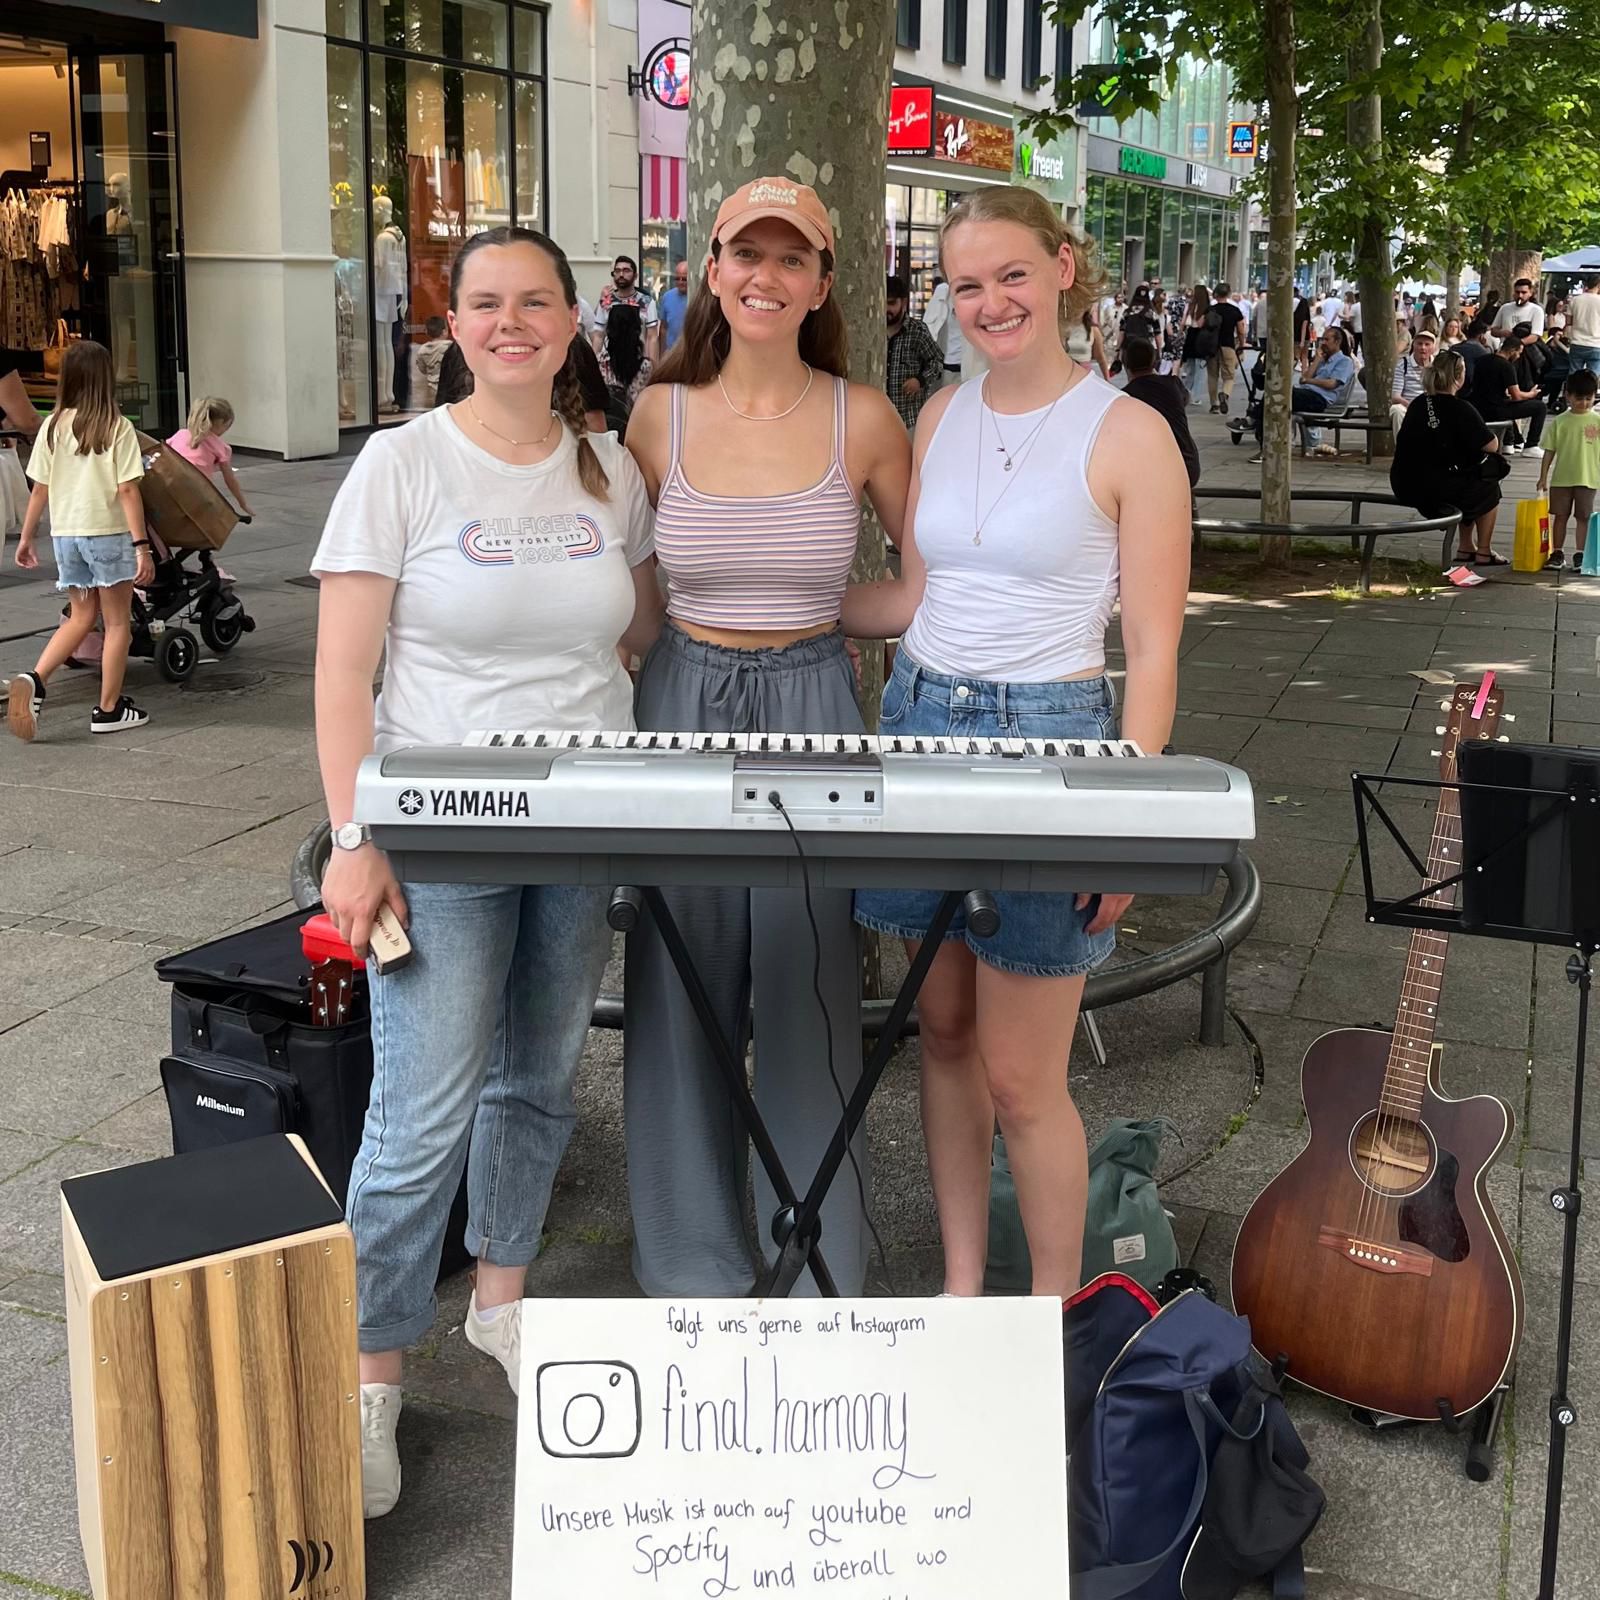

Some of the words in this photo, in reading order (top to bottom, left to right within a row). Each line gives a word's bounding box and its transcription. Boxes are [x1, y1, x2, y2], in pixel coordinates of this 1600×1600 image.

[1232, 141, 1253, 149] ALDI
[1032, 147, 1064, 180] freenet
[481, 513, 579, 537] HILFIGER
[486, 538, 511, 547] NEW
[520, 536, 550, 545] YORK
[557, 532, 582, 543] CITY
[513, 545, 568, 564] 1985
[430, 789, 530, 817] YAMAHA
[196, 1094, 245, 1117] Millenium
[666, 1306, 704, 1348] folgt
[718, 1318, 747, 1334] uns
[758, 1318, 803, 1347] gerne
[816, 1311, 842, 1333] auf
[850, 1309, 925, 1348] Instagram
[662, 1356, 937, 1490] final.harmony
[541, 1502, 613, 1533] Unsere
[624, 1501, 675, 1528] Musik
[685, 1498, 706, 1520] ist
[714, 1498, 756, 1519] auch
[764, 1498, 796, 1530] auf
[808, 1497, 907, 1547] youtube
[934, 1495, 972, 1520] und
[633, 1525, 741, 1599] Spotify
[753, 1559, 796, 1589] und
[814, 1548, 895, 1583] überall
[916, 1550, 948, 1567] wo
